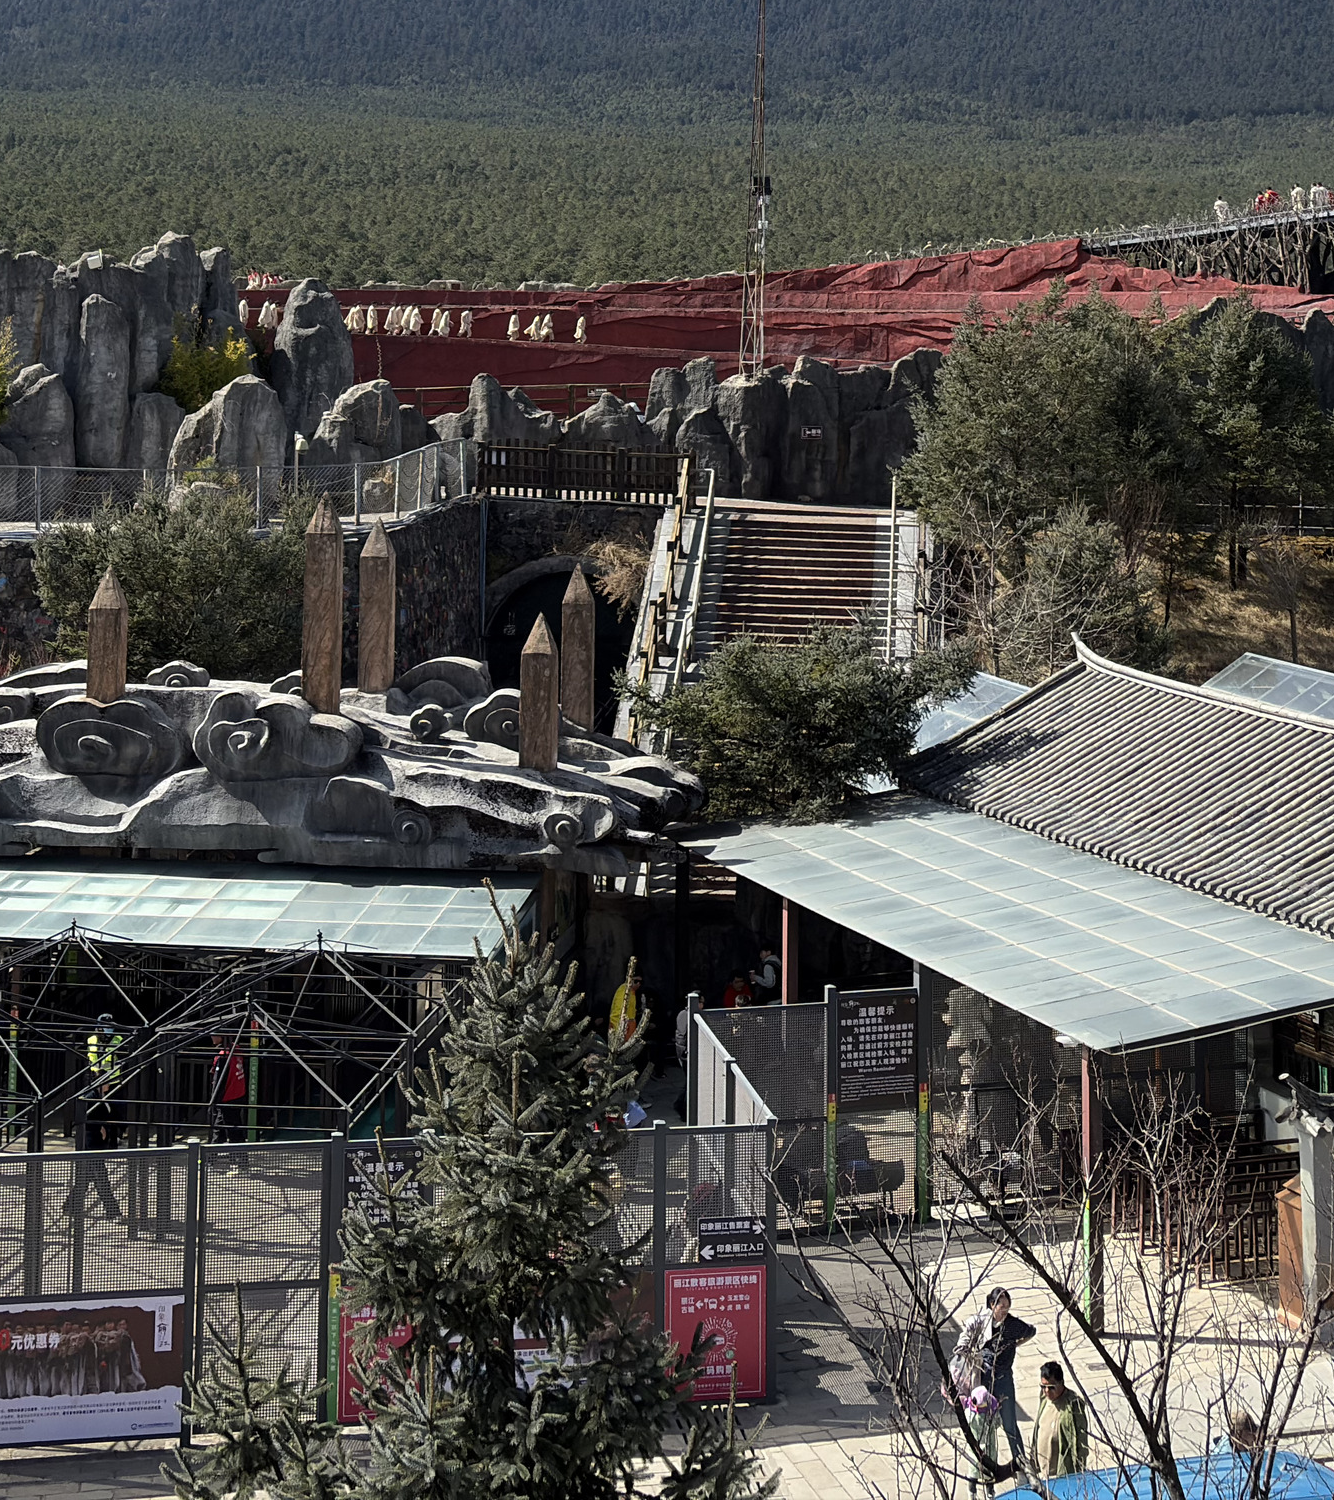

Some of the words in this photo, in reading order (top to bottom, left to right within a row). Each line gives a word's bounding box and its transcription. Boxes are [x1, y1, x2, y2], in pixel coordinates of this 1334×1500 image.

[858, 1005, 895, 1017] 温馨提示
[716, 1243, 765, 1253] 印象丽江入口
[703, 1365, 733, 1376] 码购票
